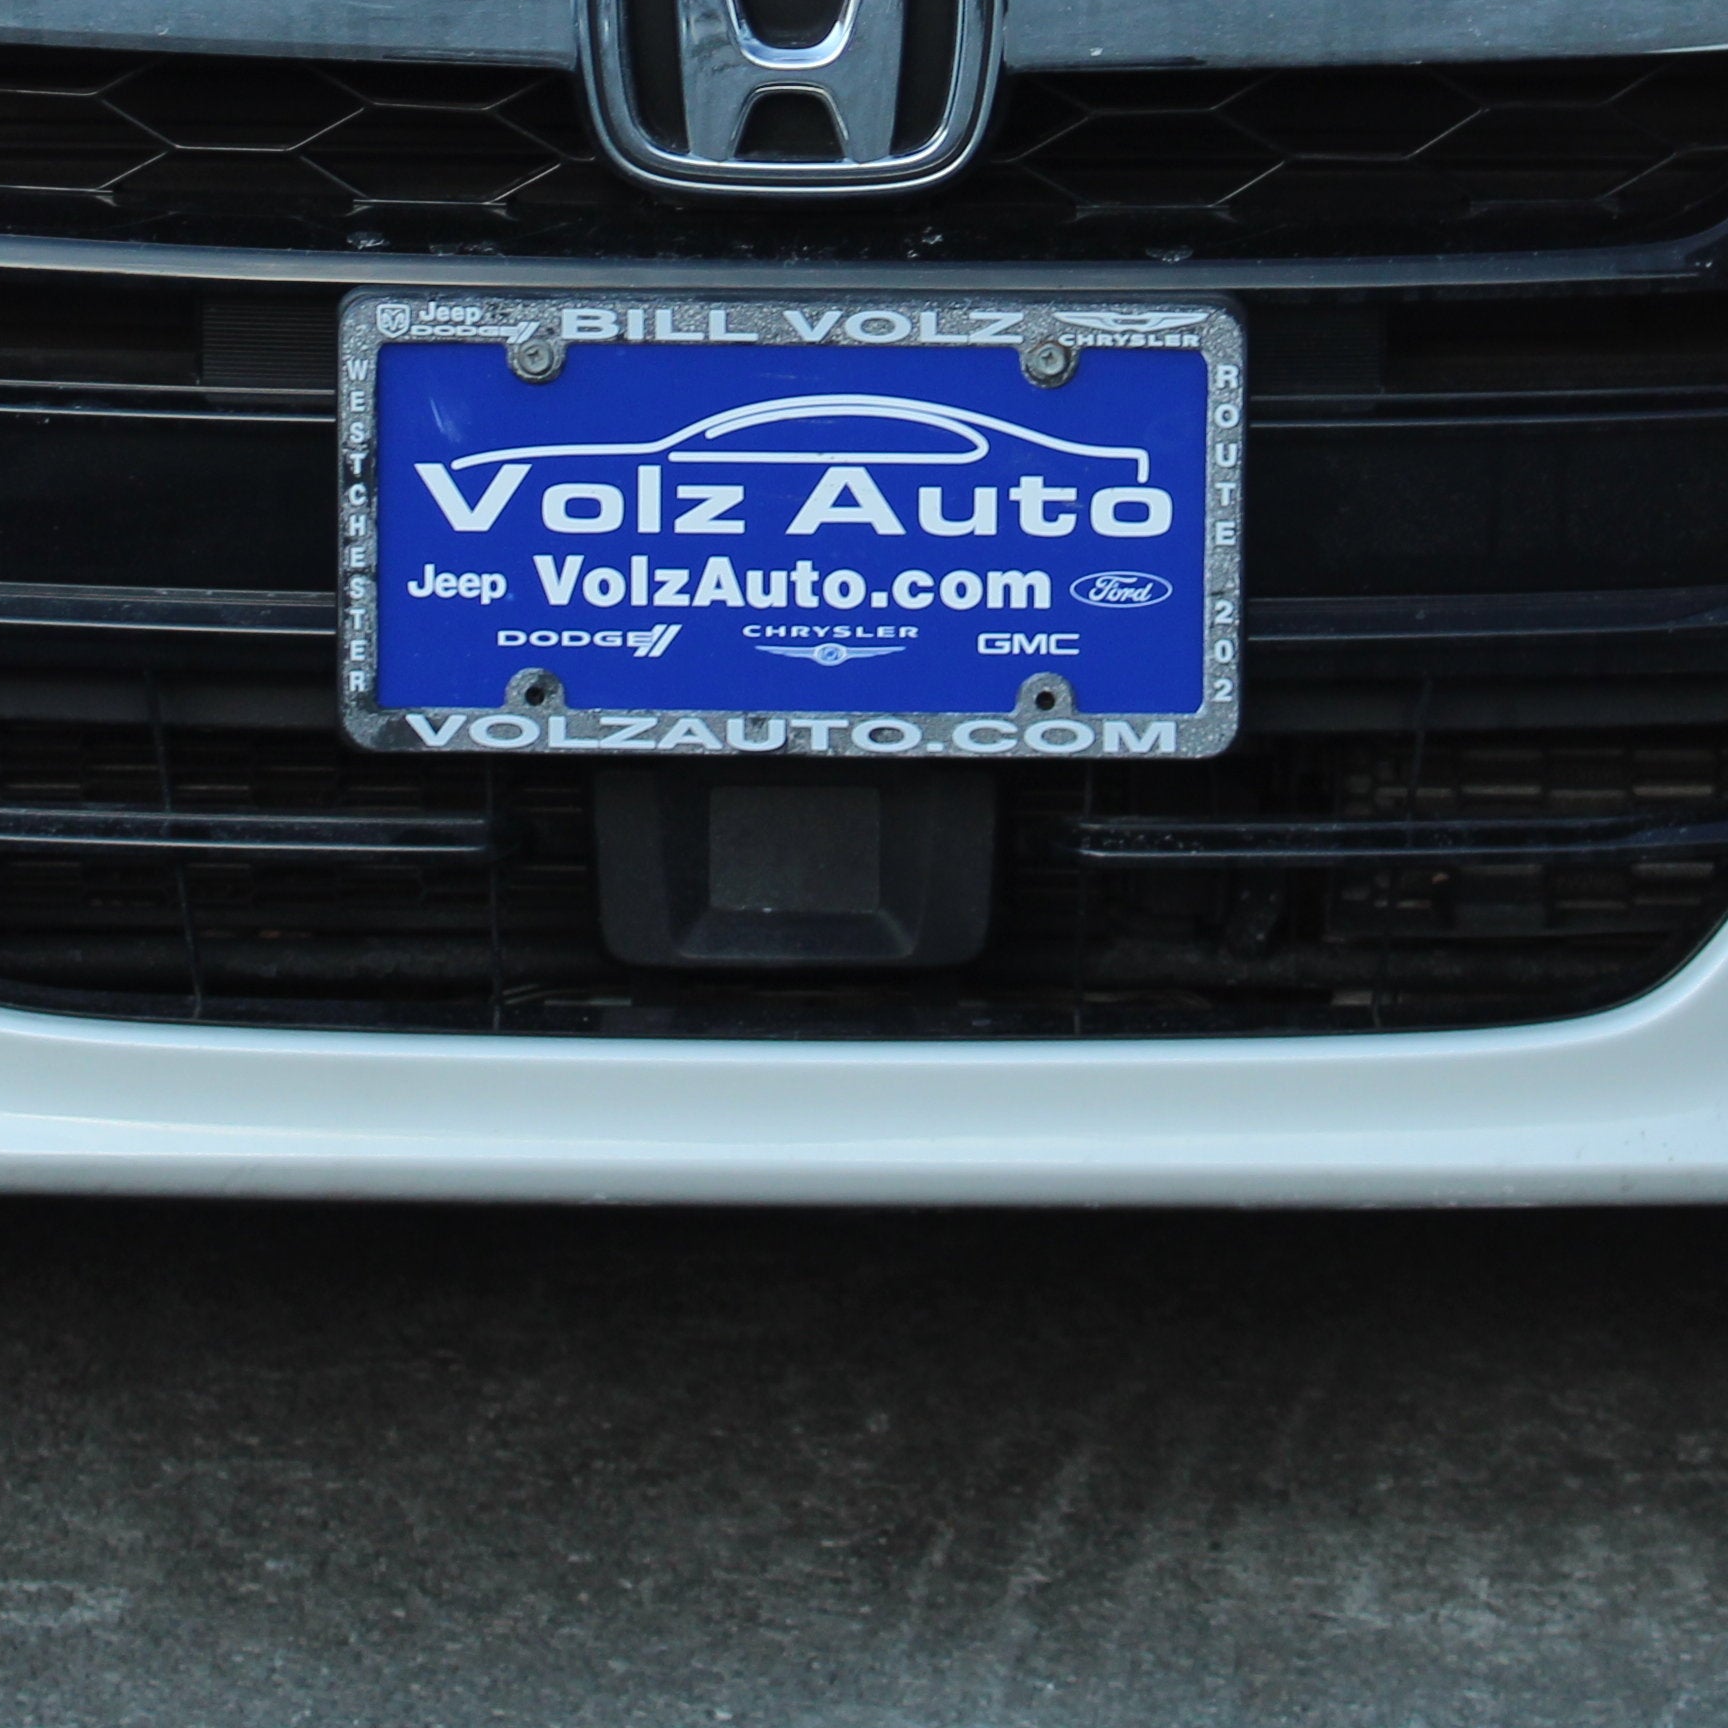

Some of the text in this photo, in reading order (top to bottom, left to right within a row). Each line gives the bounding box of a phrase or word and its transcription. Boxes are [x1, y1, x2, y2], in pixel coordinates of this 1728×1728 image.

[419, 301, 482, 323] Jeep
[561, 308, 1024, 343] BILL VOLZ
[411, 324, 526, 338] DODGE
[1058, 333, 1202, 348] CHRYSLER
[414, 462, 1173, 537] Volz Auto
[347, 359, 369, 693] WESTCHESTER
[1213, 365, 1239, 703] ROUTE 202
[407, 563, 508, 606] Jeep
[532, 554, 1052, 610] VolzAuto.com
[1087, 576, 1153, 603] Ford
[497, 628, 658, 648] DODGE
[741, 624, 919, 639] CHRYSLER
[976, 632, 1081, 656] GMC
[405, 713, 1177, 754] VOLZAUTO.COM
